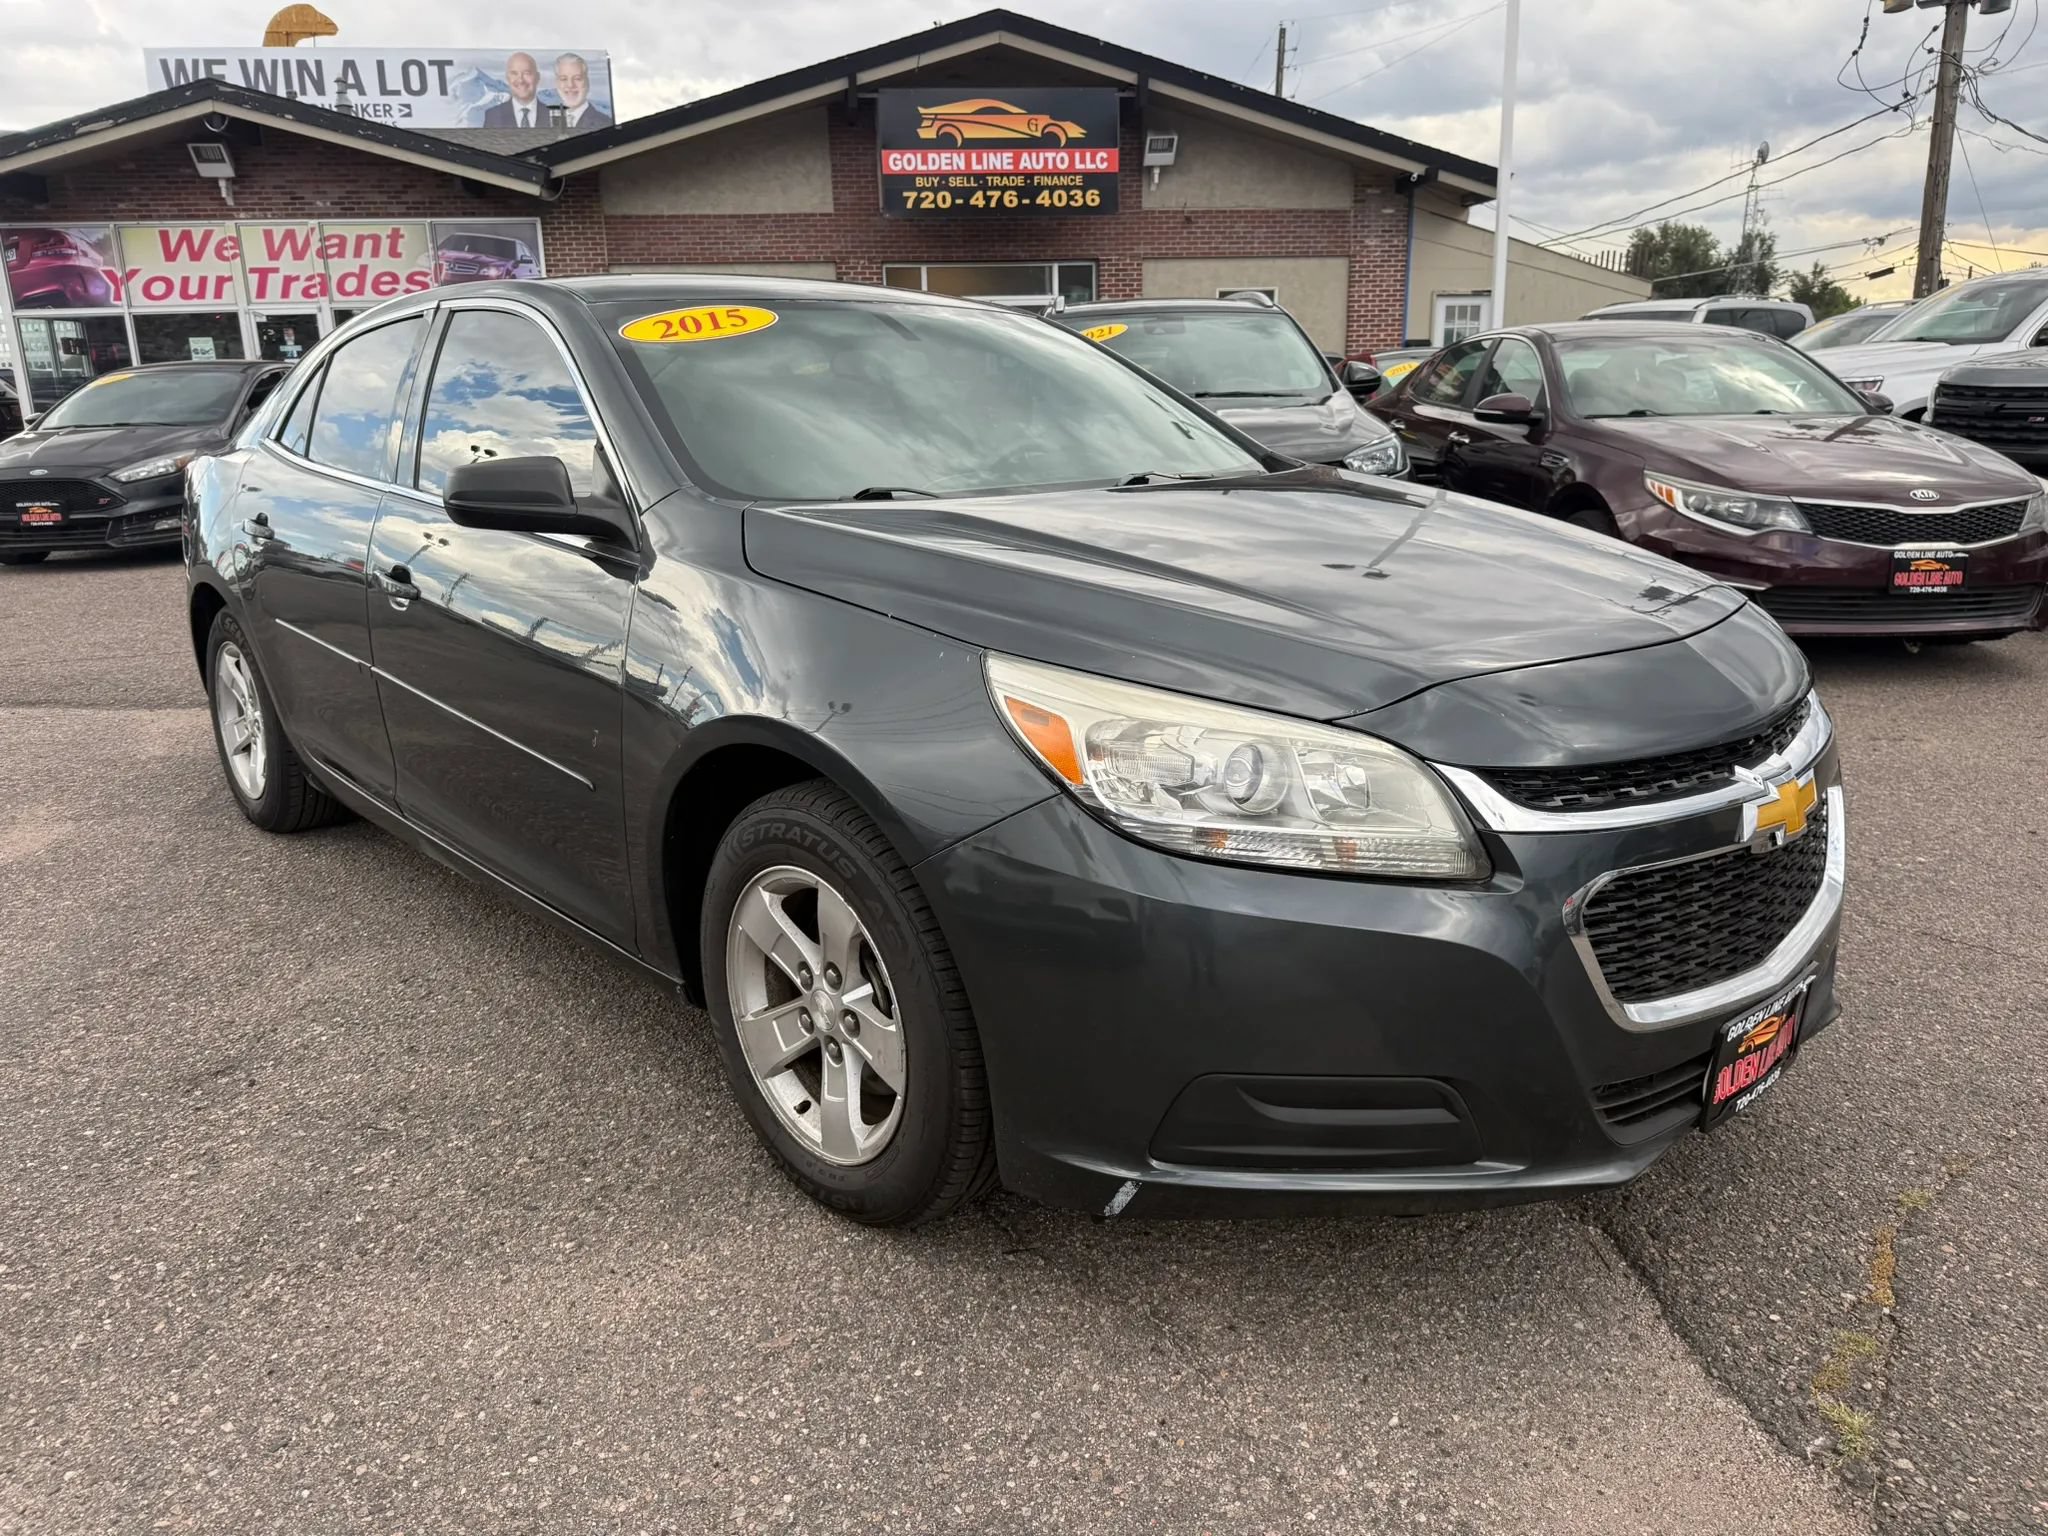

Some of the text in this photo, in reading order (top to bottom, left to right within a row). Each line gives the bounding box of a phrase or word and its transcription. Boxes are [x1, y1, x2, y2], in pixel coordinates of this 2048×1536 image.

[238, 58, 327, 97] WIN
[337, 59, 366, 96] A
[376, 59, 454, 97] LOT
[888, 151, 1109, 172] GOLDEN LINE AUTO LLC
[915, 175, 1084, 188] BUY SELL TRADE FINANCE
[157, 226, 405, 263] We Want
[102, 267, 234, 303] Your
[652, 308, 748, 339] 2015
[1086, 326, 1112, 339] 021
[740, 822, 857, 880] STRATUS
